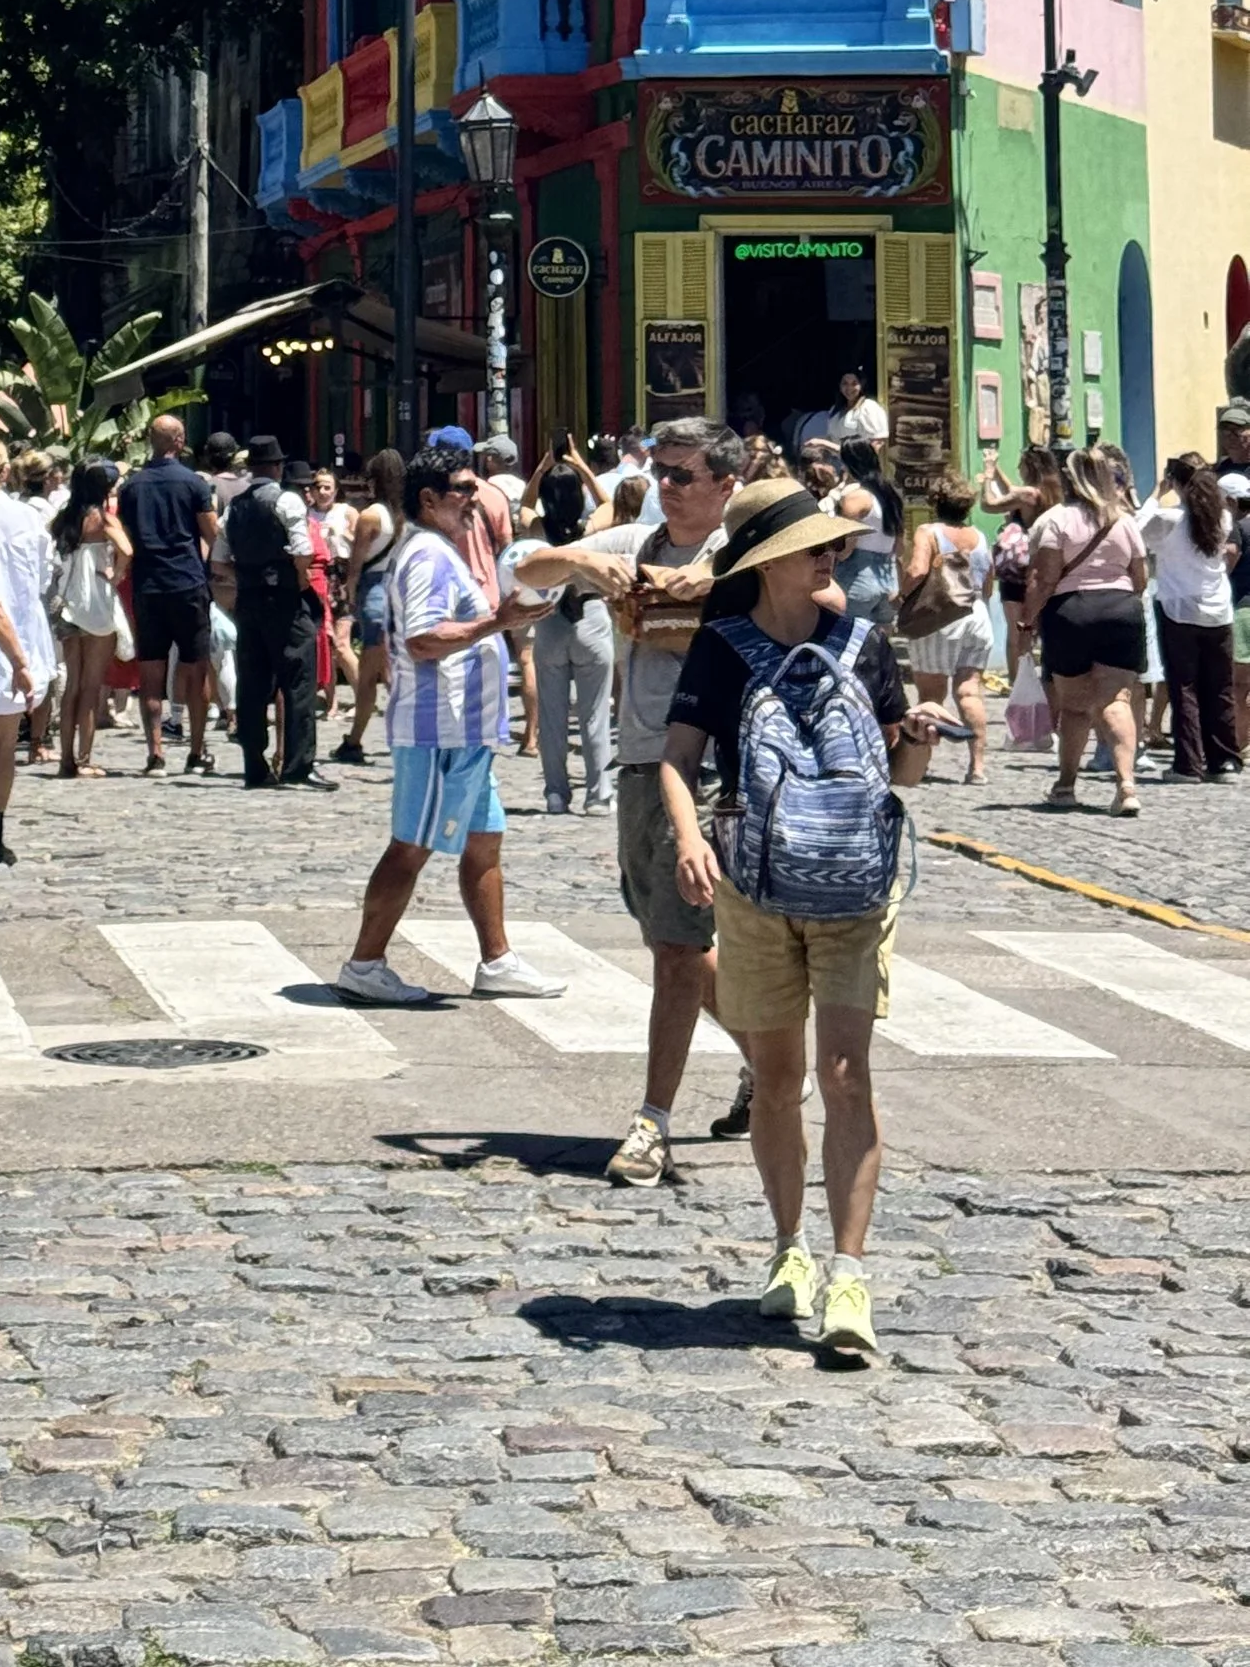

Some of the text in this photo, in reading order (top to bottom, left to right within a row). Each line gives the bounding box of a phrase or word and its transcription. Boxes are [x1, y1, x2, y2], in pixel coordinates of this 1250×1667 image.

[695, 135, 892, 178] CAMINITO
[742, 180, 843, 189] BUENOS AIRES
[735, 242, 863, 260] @VISITCAMINITO
[648, 332, 702, 343] ALFAJOR
[890, 334, 946, 346] ALFAJOR
